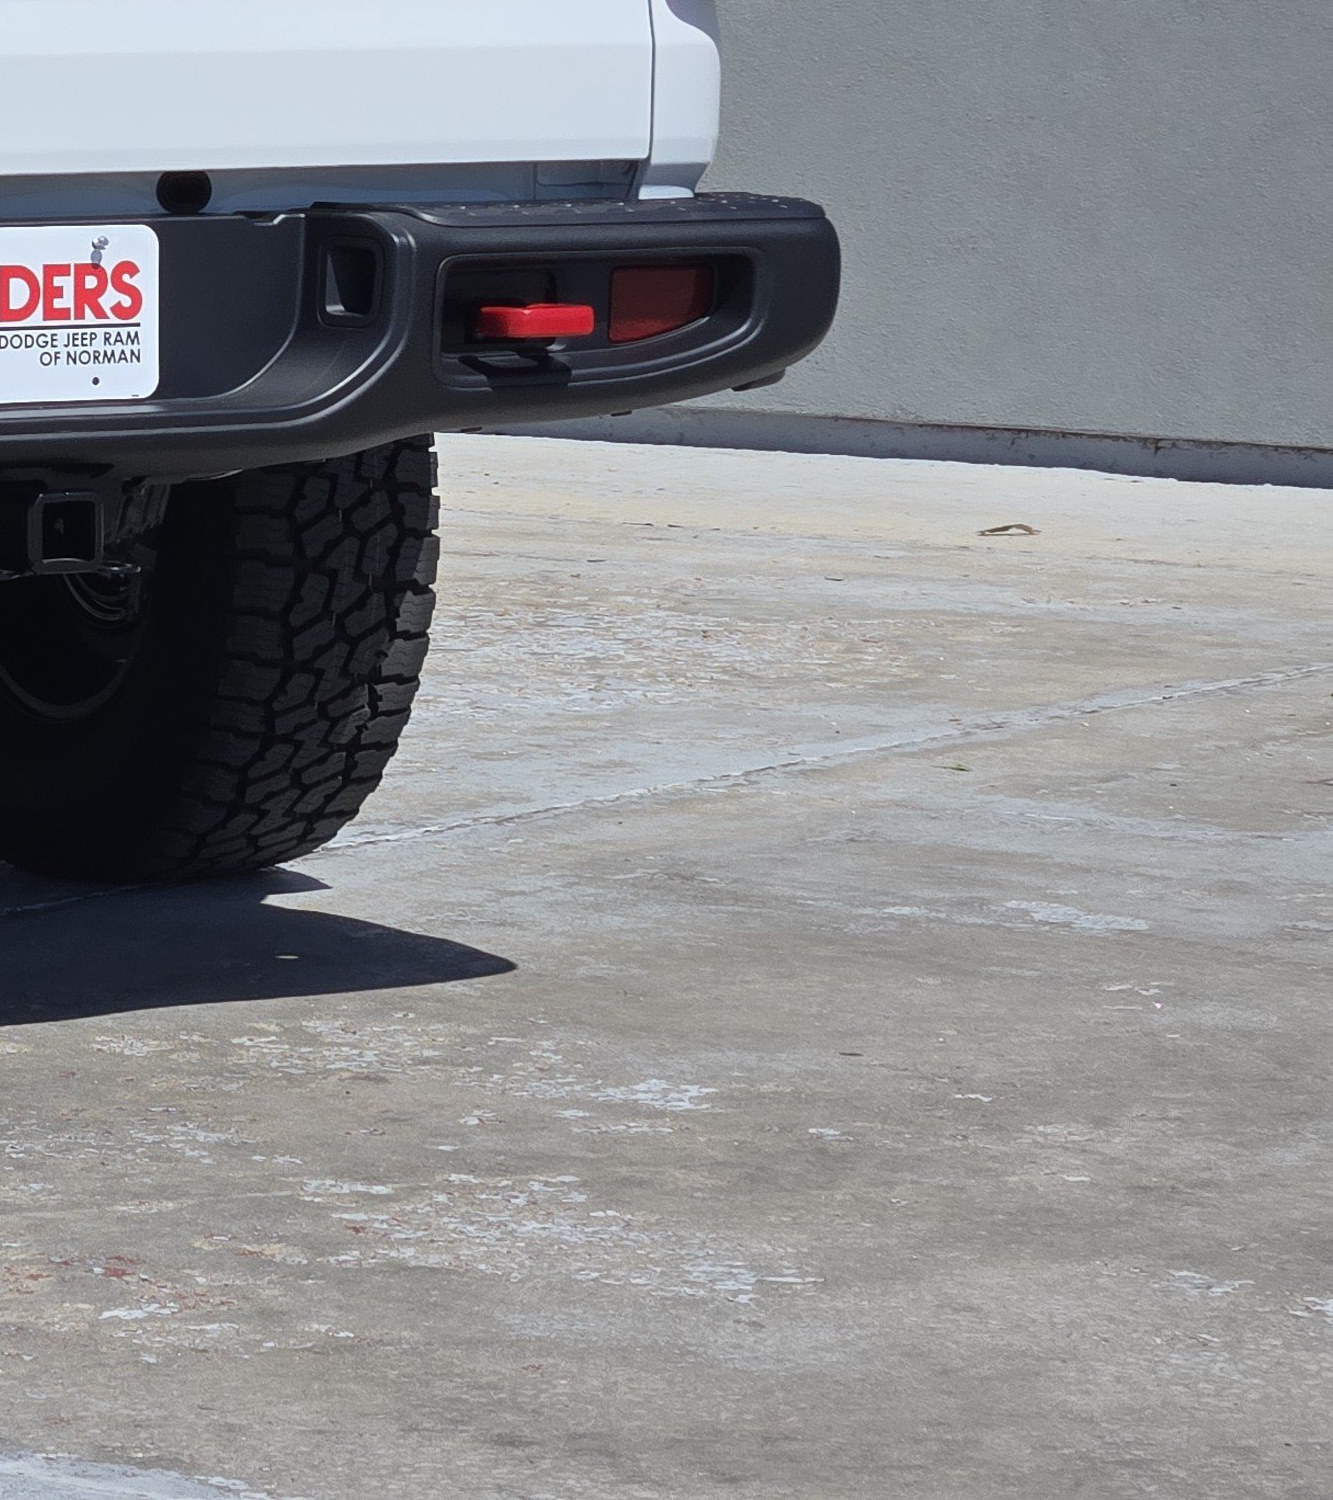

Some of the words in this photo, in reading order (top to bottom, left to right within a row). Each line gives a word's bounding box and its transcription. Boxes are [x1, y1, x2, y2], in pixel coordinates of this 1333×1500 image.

[63, 332, 97, 348] JEEP
[103, 331, 141, 347] RAM
[39, 351, 61, 366] OF
[66, 349, 141, 366] NORMAN
